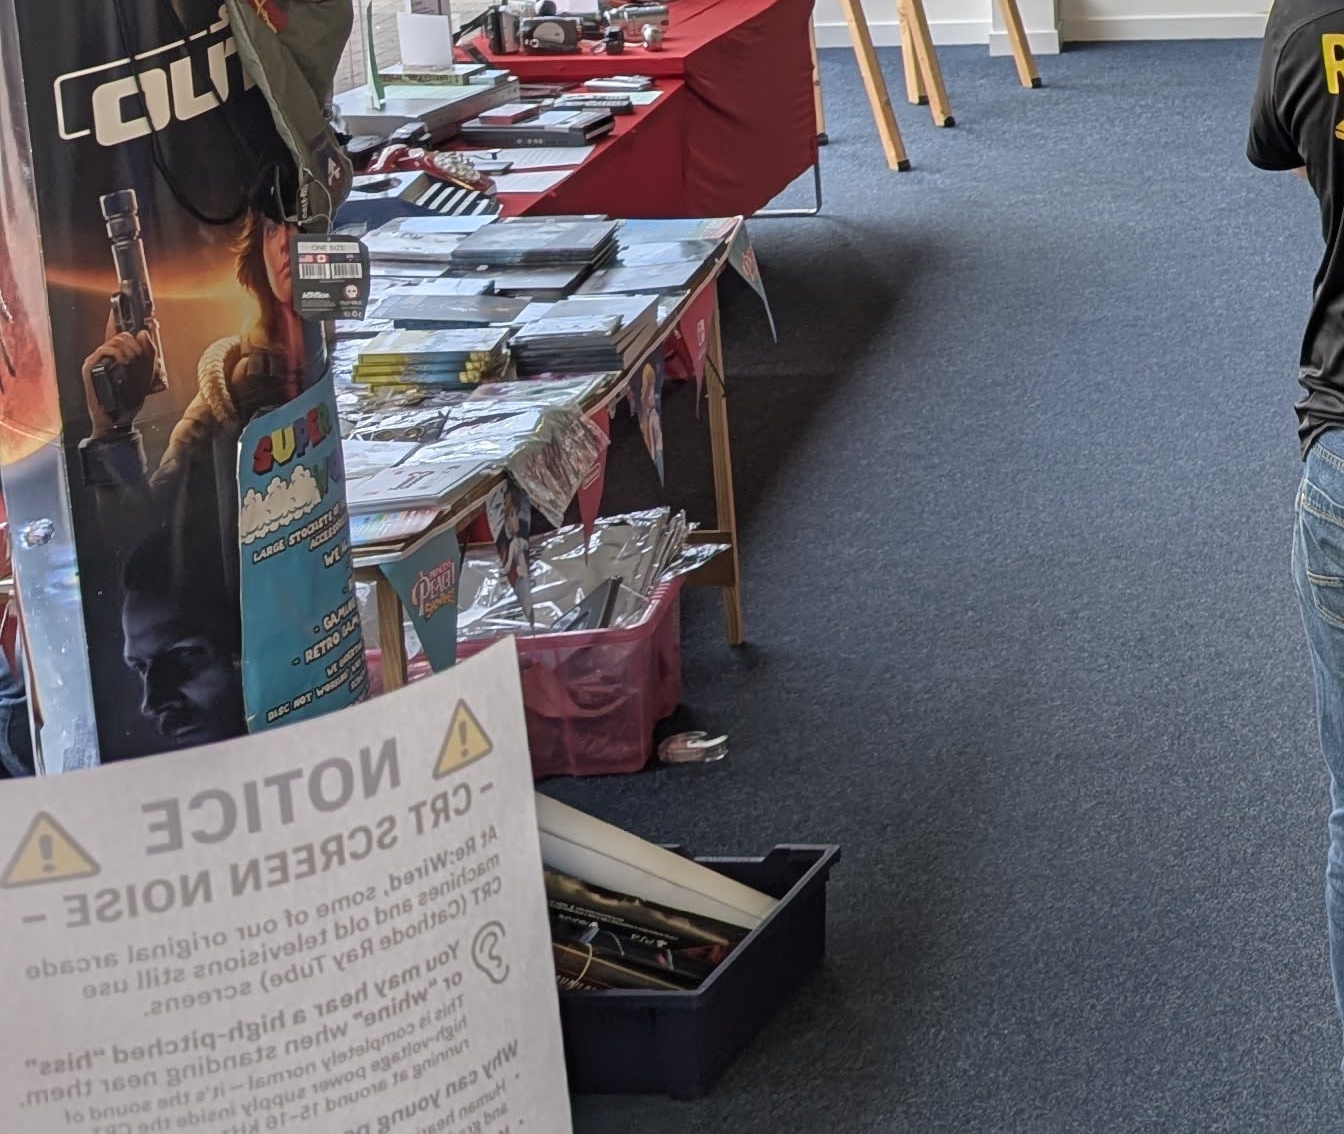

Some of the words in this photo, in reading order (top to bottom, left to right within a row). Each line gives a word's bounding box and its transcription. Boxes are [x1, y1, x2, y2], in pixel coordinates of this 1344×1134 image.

[252, 401, 332, 476] SUPER
[252, 539, 286, 564] LARGE
[323, 547, 341, 568] WE
[304, 631, 341, 664] RETRO
[267, 702, 291, 723] DISC
[293, 691, 314, 711] NOT
